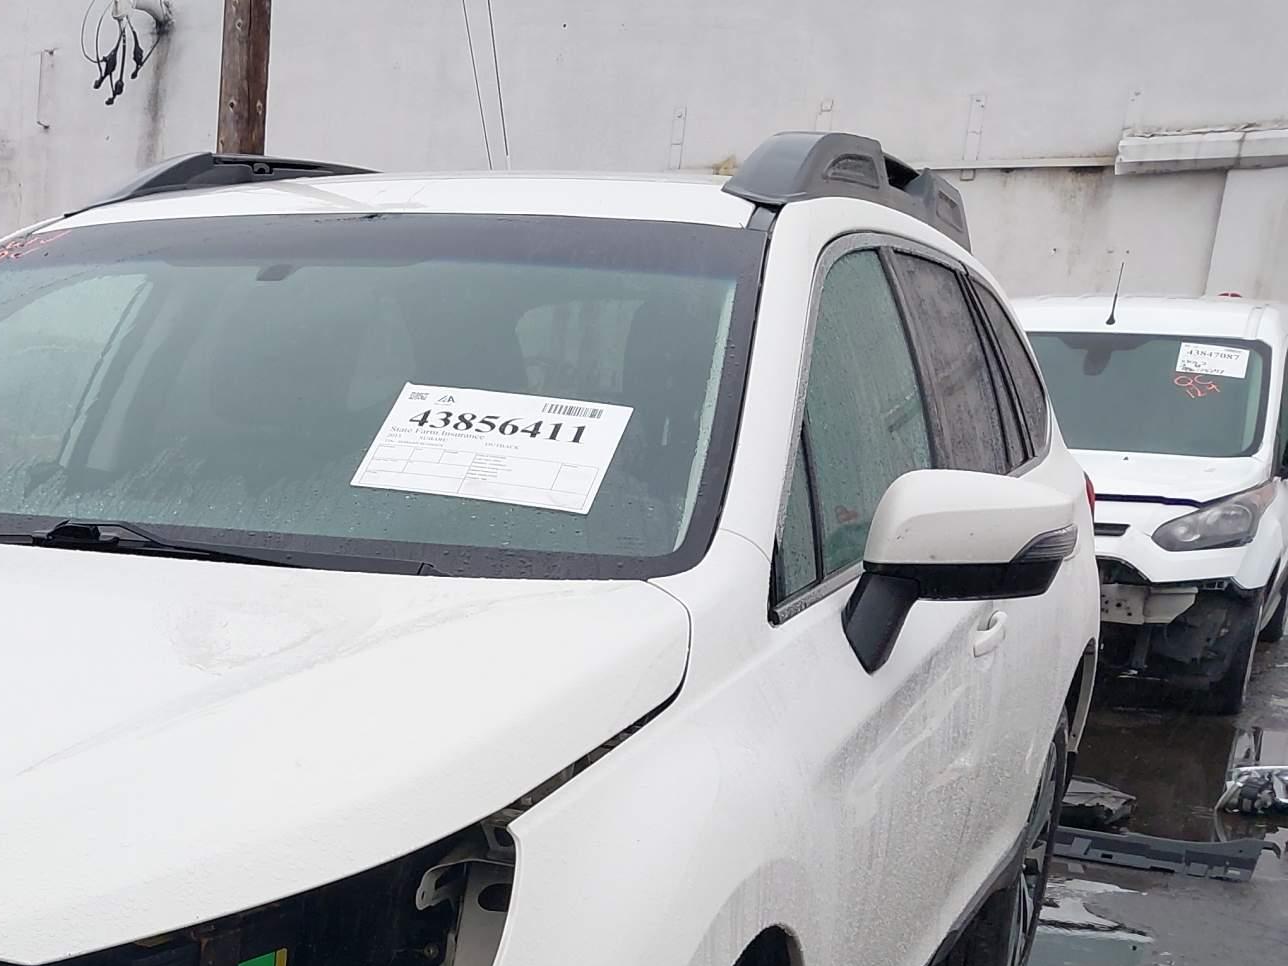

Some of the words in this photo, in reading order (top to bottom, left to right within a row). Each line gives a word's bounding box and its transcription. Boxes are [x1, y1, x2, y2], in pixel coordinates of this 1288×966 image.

[392, 426, 413, 434] State
[415, 428, 439, 436] Farm
[441, 429, 486, 440] Insurance
[408, 408, 587, 445] 43856411
